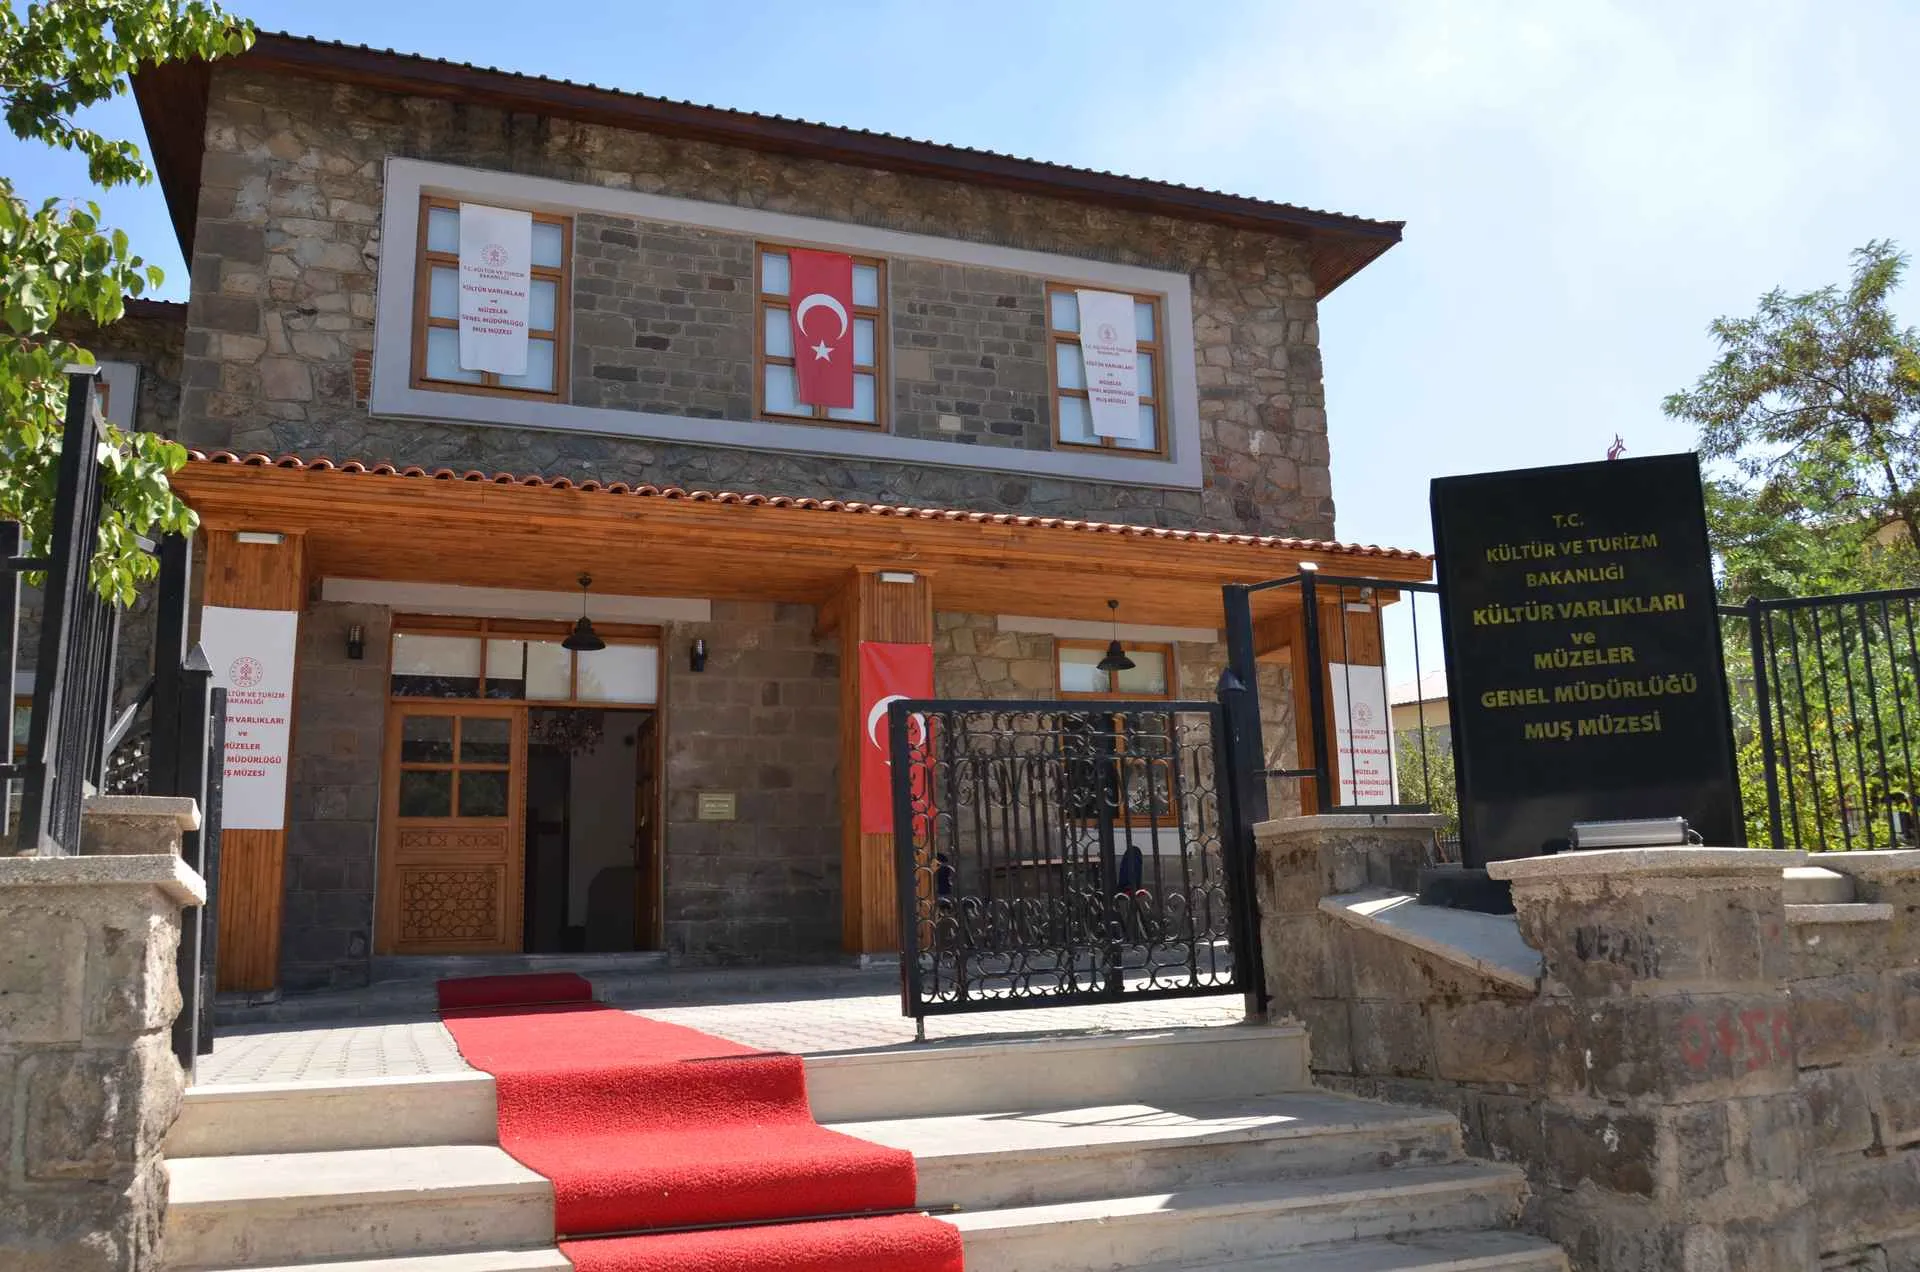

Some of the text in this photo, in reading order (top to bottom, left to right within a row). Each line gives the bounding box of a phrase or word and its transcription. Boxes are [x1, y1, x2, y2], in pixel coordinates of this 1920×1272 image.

[1552, 513, 1584, 528] T.C.
[1486, 532, 1659, 563] KÜLTÜR VE TURİZM
[1525, 563, 1624, 588] BAKANLIĞI
[1473, 593, 1685, 626] KÜLTÜR VARLIKLARI
[1570, 631, 1596, 645] ve
[1534, 646, 1635, 670] MÜZELER
[1481, 673, 1698, 708] GENEL MÜDÜRLÜĞÜ
[235, 716, 284, 725] VARLIKLARI
[1524, 711, 1662, 741] MUŞ MÜZESİ
[226, 755, 282, 764] MÜDÜRLÜĞÜ
[234, 769, 266, 777] MÜZESİ
